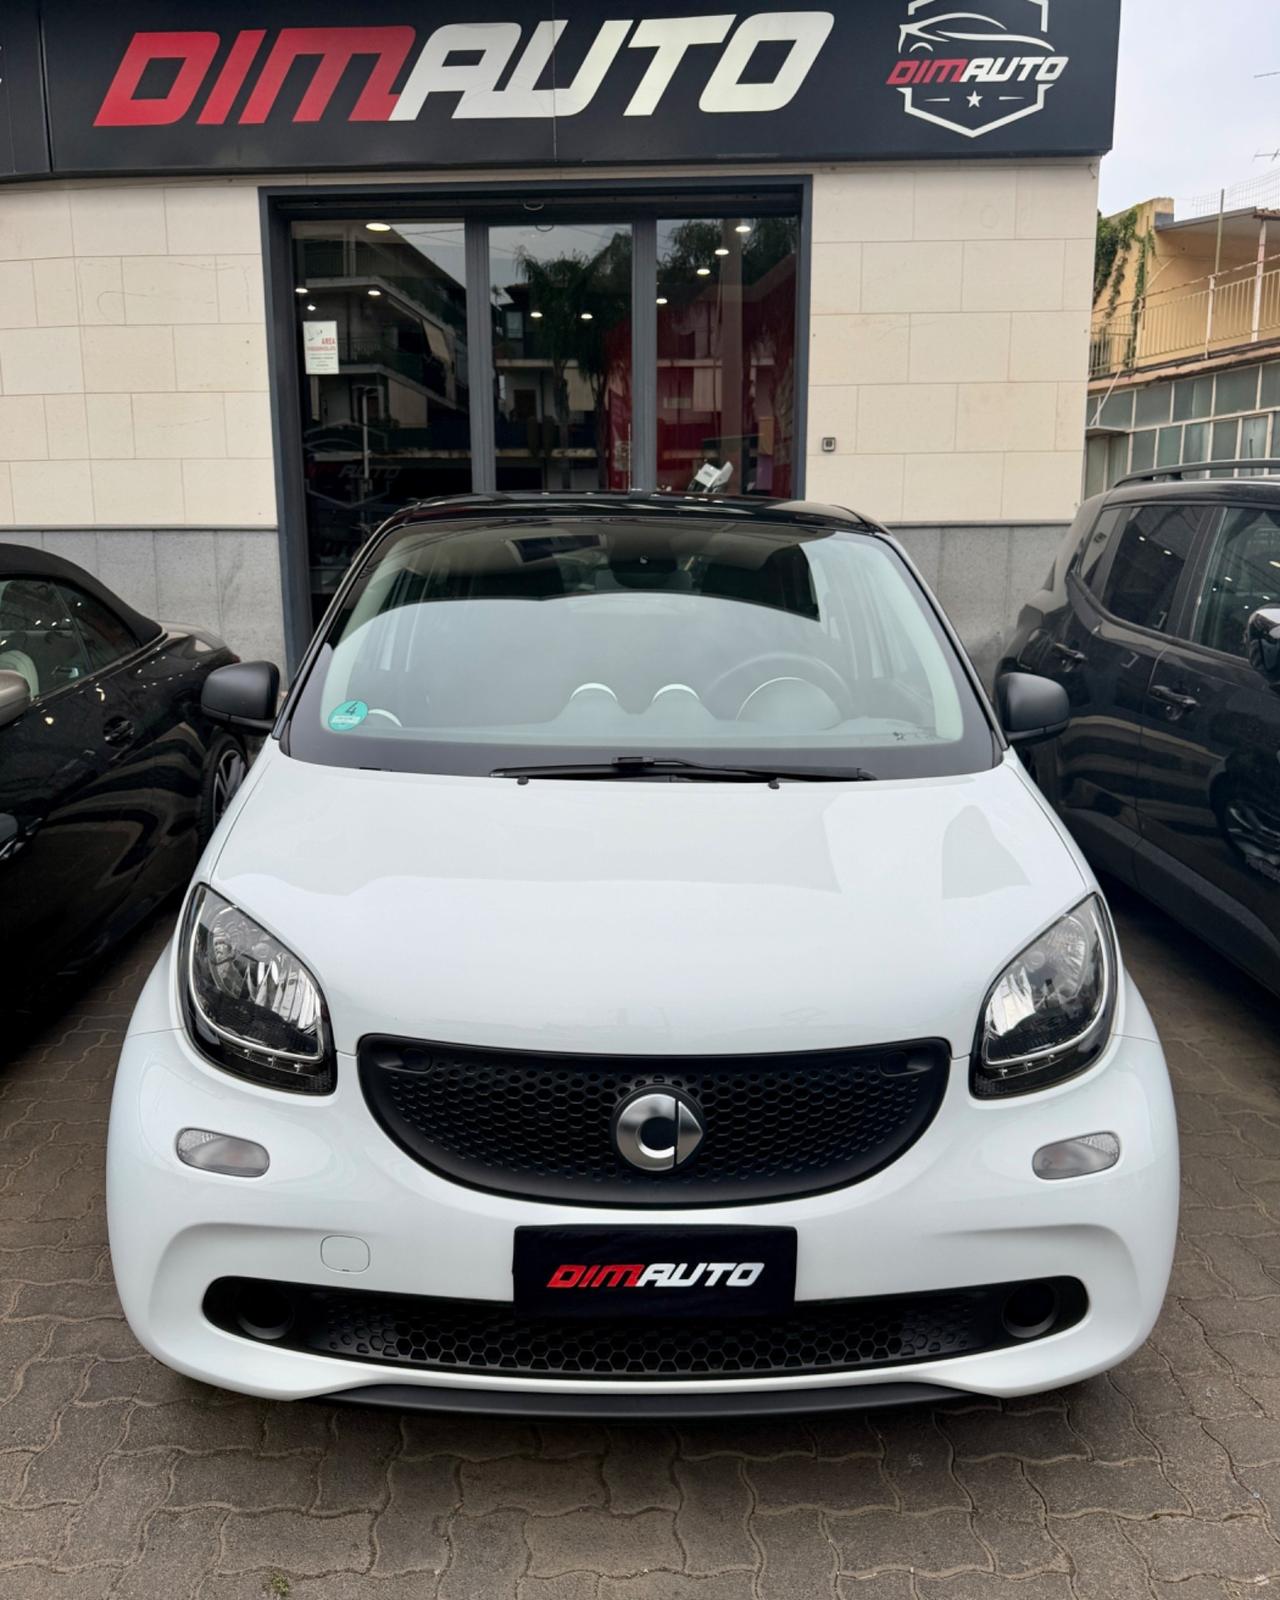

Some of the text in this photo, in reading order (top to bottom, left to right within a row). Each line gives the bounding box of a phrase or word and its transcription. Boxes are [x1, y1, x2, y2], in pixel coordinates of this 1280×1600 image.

[93, 11, 835, 126] DIMAUTO
[886, 56, 1069, 85] DIMAUTO
[345, 702, 358, 715] 4
[547, 1263, 765, 1287] DIMAUTO
